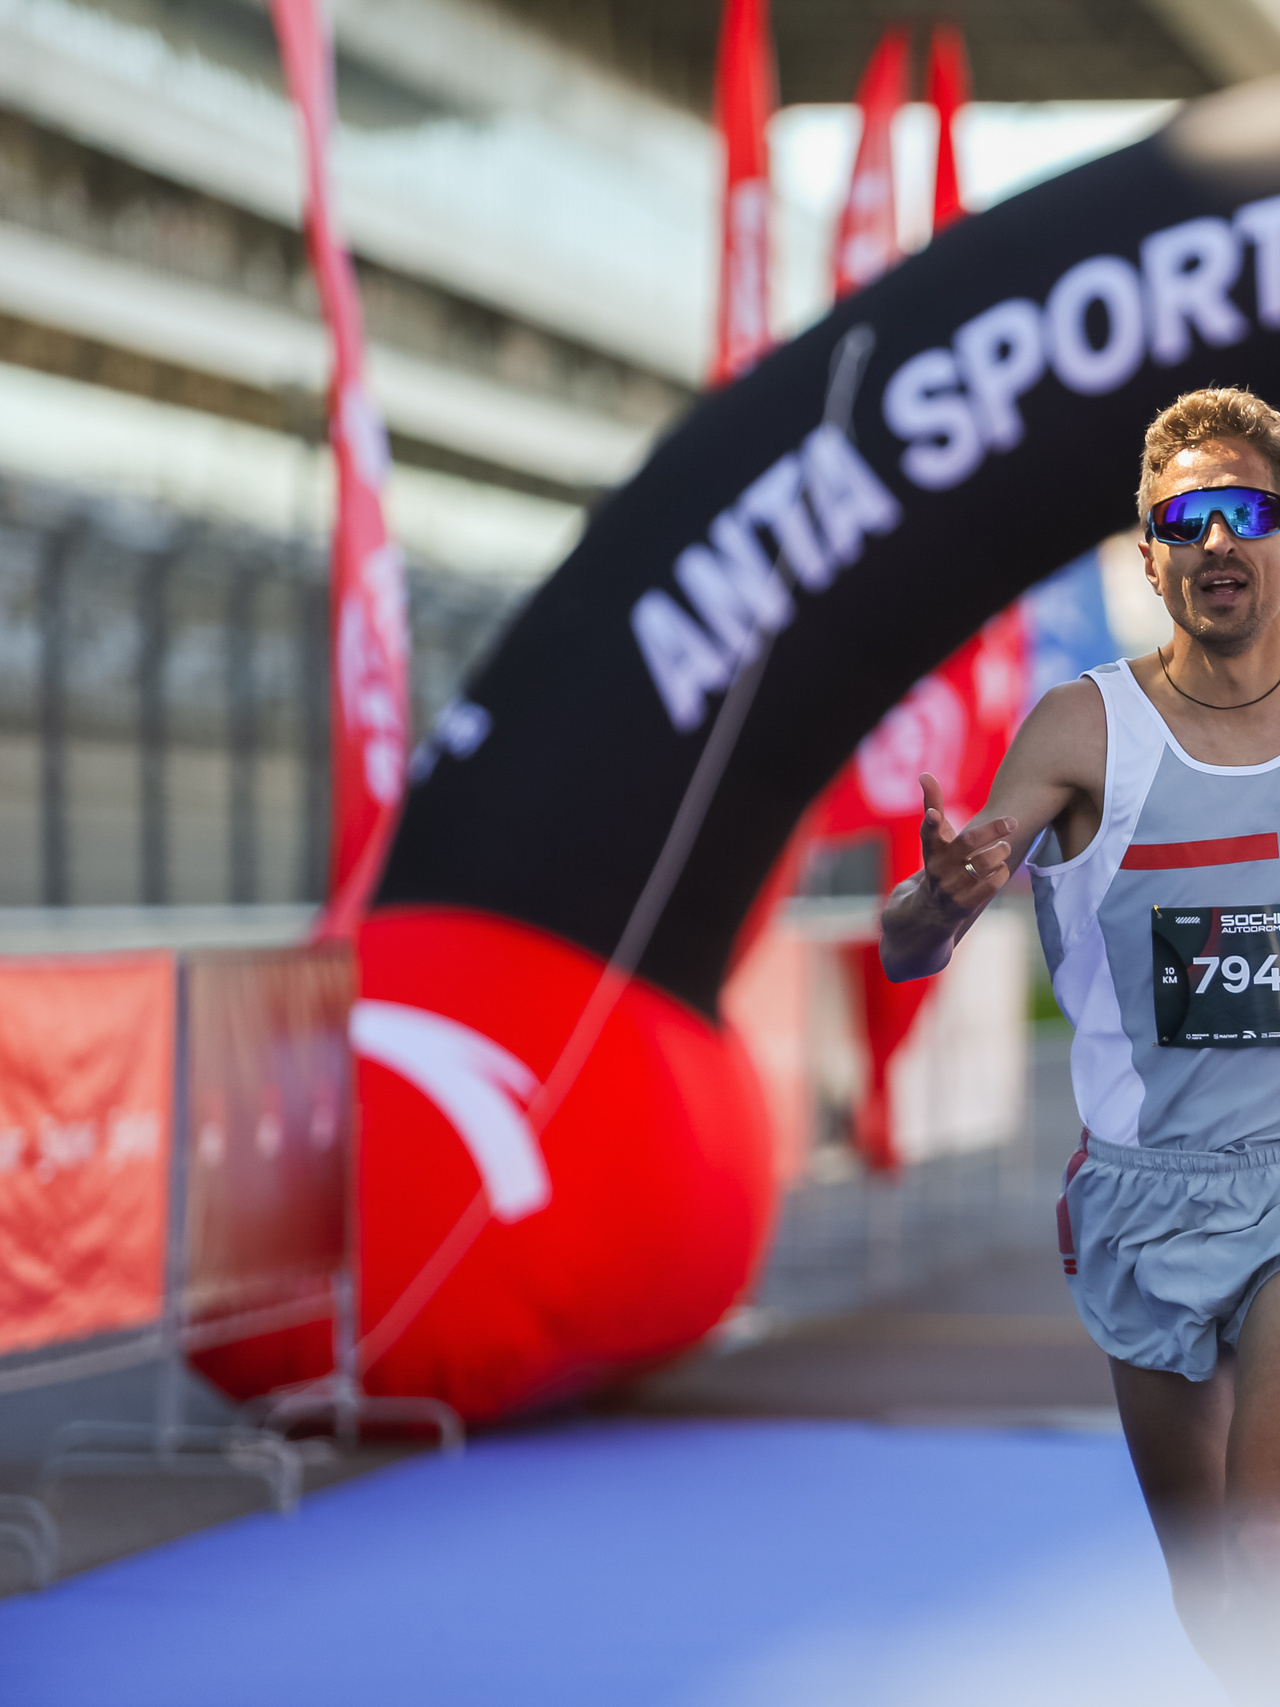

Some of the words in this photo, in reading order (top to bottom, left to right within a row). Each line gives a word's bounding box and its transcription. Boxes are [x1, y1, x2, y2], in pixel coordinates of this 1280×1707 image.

[631, 423, 901, 733] ANTA
[1220, 912, 1280, 926] SOCHI
[1221, 925, 1280, 934] AUTODROM
[1164, 966, 1175, 975] 10
[1162, 975, 1178, 984] KM
